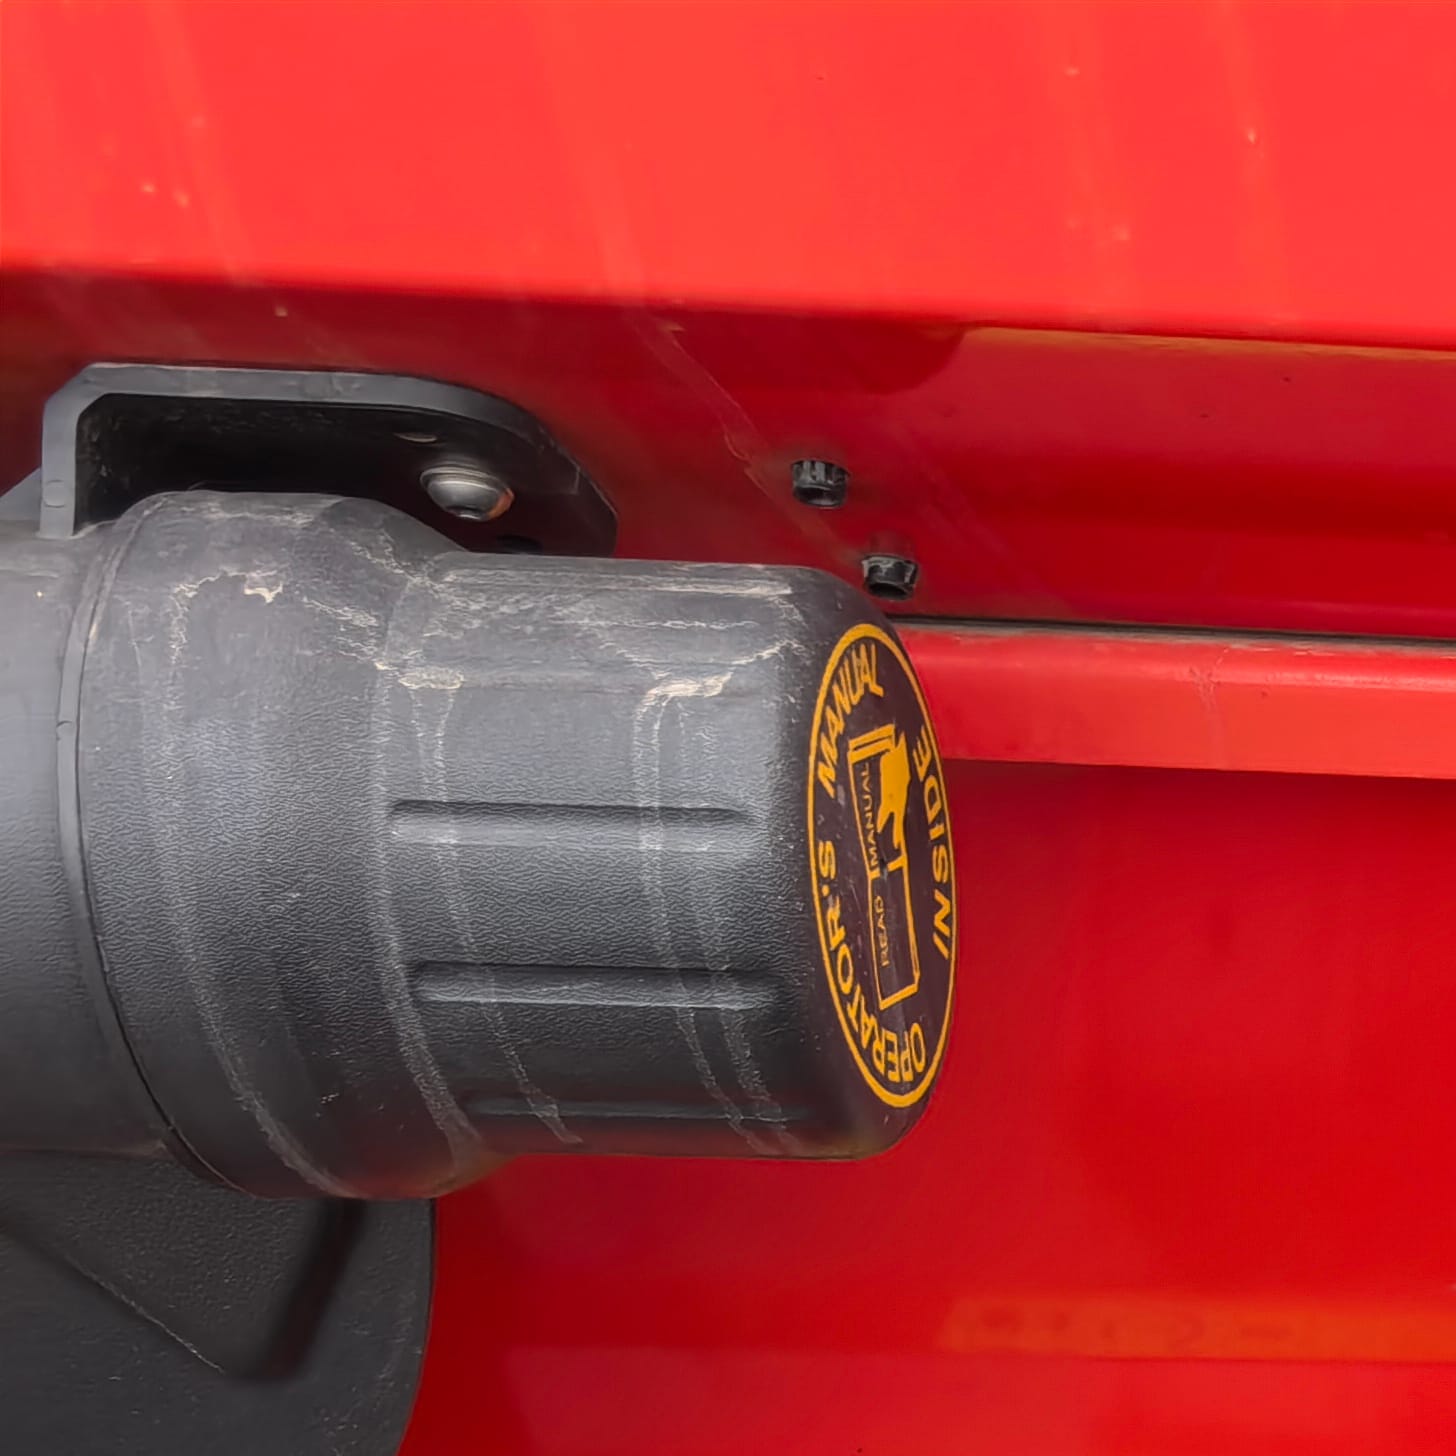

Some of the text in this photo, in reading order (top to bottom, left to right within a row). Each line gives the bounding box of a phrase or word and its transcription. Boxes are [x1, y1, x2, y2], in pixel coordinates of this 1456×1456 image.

[817, 642, 926, 1083] OPERATOR'S MANUAL
[860, 762, 890, 968] READ MANUAL
[913, 725, 951, 960] INSIDE
